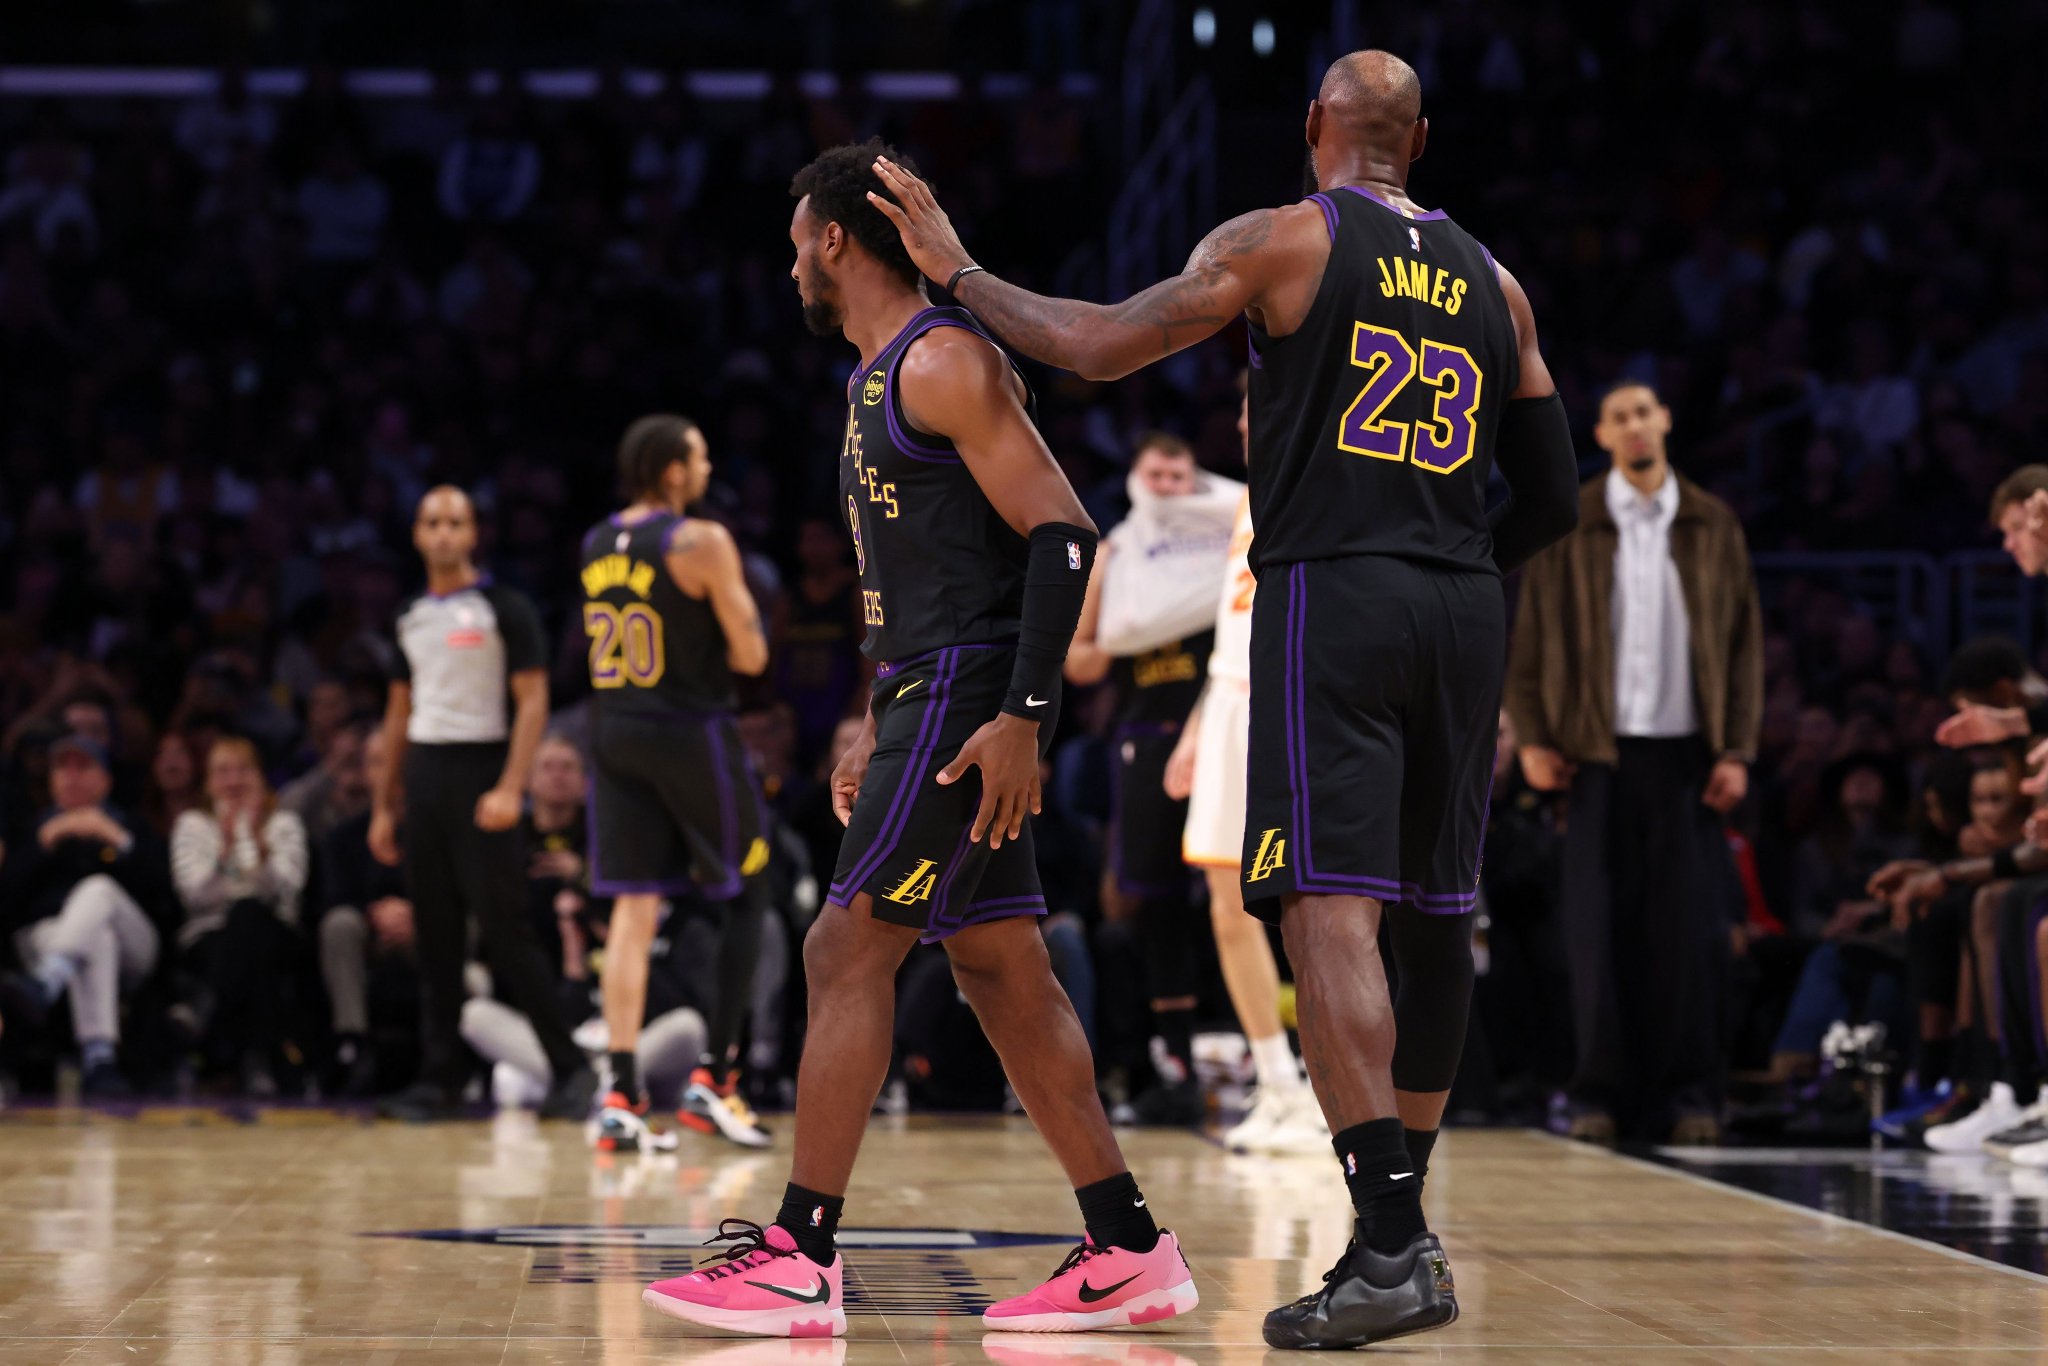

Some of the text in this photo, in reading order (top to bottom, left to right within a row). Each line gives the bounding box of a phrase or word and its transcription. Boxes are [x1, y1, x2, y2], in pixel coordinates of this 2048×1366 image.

[1377, 256, 1467, 316] JAMES
[1337, 320, 1483, 475] 23
[862, 590, 884, 626] ERS
[582, 601, 666, 689] 20
[881, 858, 938, 906] LA
[1246, 828, 1286, 883] LA
